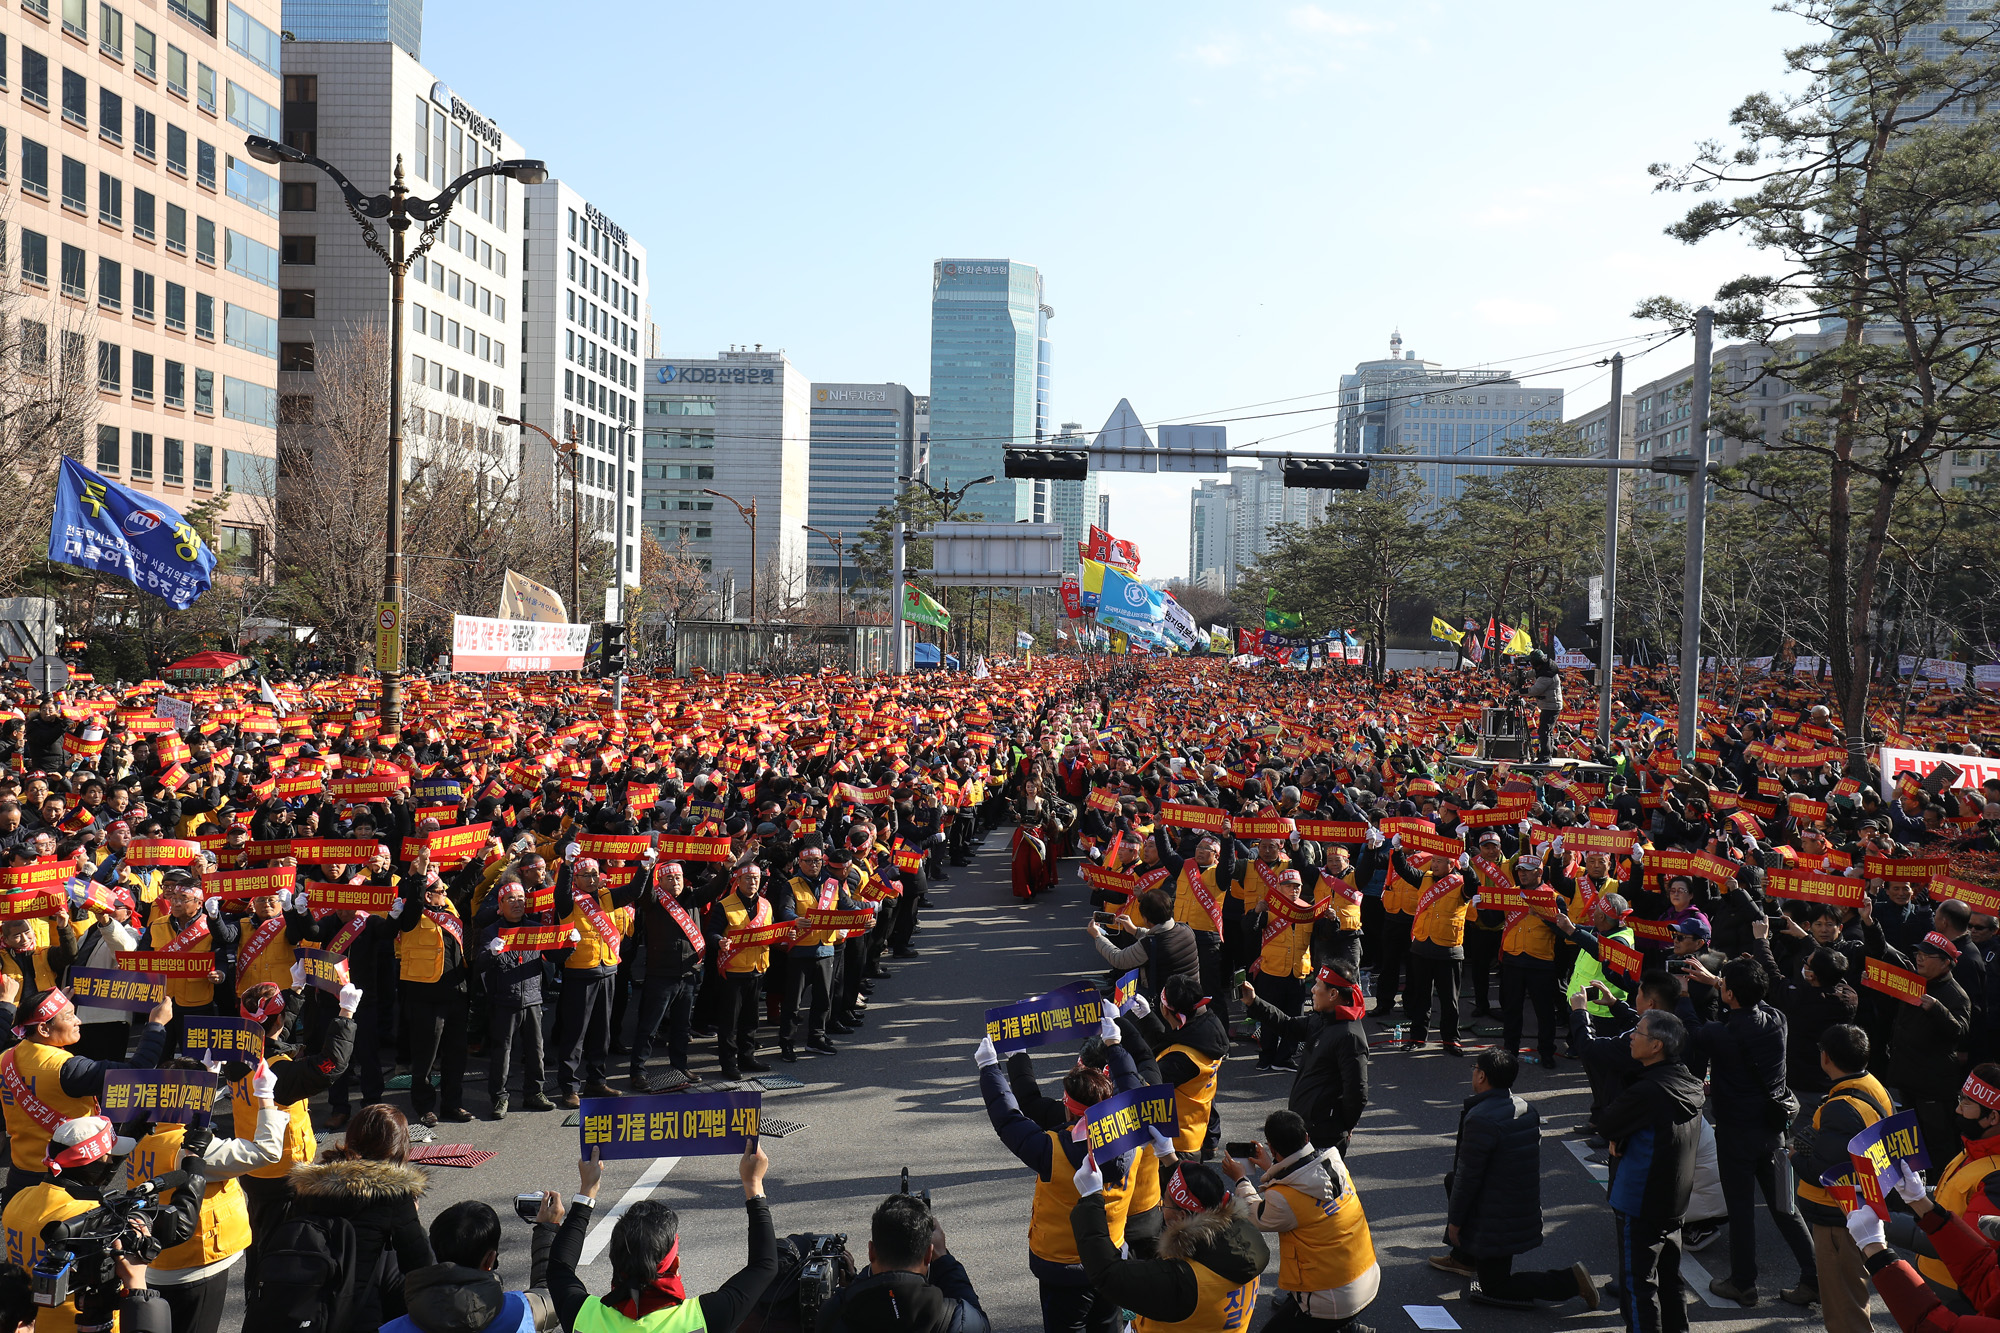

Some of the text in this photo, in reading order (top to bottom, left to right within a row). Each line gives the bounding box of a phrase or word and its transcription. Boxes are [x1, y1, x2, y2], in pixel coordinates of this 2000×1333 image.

[957, 265, 1007, 275] 한화손해보험
[679, 367, 774, 385] KDB산업은행
[829, 390, 886, 403] NH투자증권
[80, 478, 202, 562] 투 쟁
[1162, 807, 1224, 825] 카풀 앱 불법영업 OUT!
[430, 837, 442, 850] 카풀
[442, 836, 449, 848] 앱
[451, 832, 473, 846] 불법영업
[1297, 824, 1367, 840] 카풀 앱 불법영업 OUT!
[293, 845, 377, 858] 카풀 앱 불법영업 OUT!
[578, 840, 650, 856] 카풀 앱 불법영업 OUT!
[660, 841, 730, 856] 카풀 앱 불법영업 OUT!
[1400, 831, 1462, 856] 카풀 앱 불법영업 OUT!
[1563, 832, 1636, 852] 카풀 앱 불법영업 OUT!
[2, 866, 76, 885] 카풀 앱 불법영업 OUT!
[1866, 861, 1948, 880] 카풀 앱 불법영업 OUT!
[204, 873, 294, 893] 카풀 앱 불법영업 OUT!
[1769, 875, 1862, 900] 카풀 앱 불법영업 OUT!
[306, 888, 323, 902] 카풀
[326, 889, 335, 902] 앱
[337, 890, 370, 904] 불법영업
[118, 957, 212, 972] 카풀 앱 불법영업 OUT!
[1867, 964, 1924, 999] 카풀 앱 불법영업 OUT!
[149, 986, 164, 1003] 삭제
[38, 999, 59, 1017] 카풀
[1001, 1016, 1019, 1040] 카풀
[1020, 1013, 1040, 1036] 방치
[1040, 1006, 1072, 1031] 여객법
[1074, 1001, 1100, 1024] 삭제!
[187, 1027, 209, 1049] 불법
[212, 1028, 233, 1050] 카풀
[236, 1030, 251, 1052] 방치
[105, 1083, 129, 1109] 불법
[133, 1084, 157, 1108] 카풀
[160, 1085, 179, 1109] 방치
[180, 1084, 201, 1111] 여객법
[584, 1107, 760, 1145] 불법 카풀 방치 여객법 삭제!
[1101, 1115, 1117, 1143] 방치
[1117, 1106, 1139, 1135] 여객법
[1140, 1096, 1174, 1124] 삭제!
[78, 1132, 112, 1160] 카풀 앱
[1886, 1125, 1919, 1160] 삭제!
